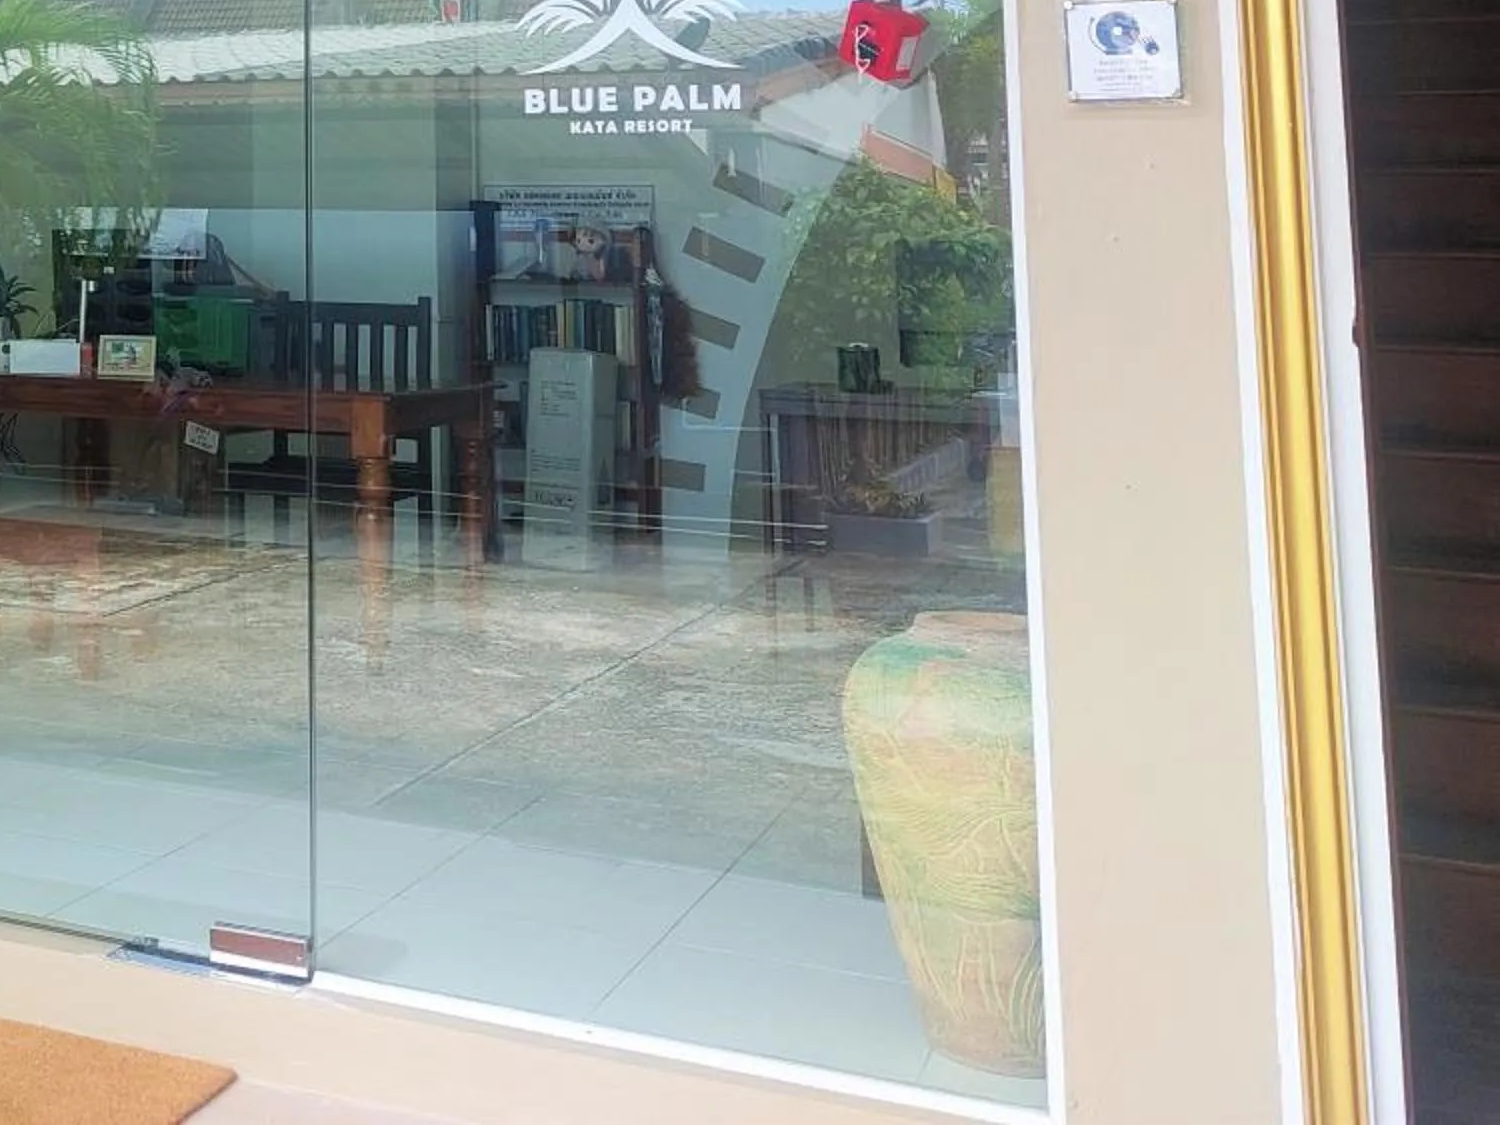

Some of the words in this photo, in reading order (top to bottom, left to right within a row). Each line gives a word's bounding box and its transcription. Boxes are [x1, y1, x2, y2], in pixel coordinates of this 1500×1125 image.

[523, 86, 618, 114] BLUE
[633, 83, 742, 112] PALM
[570, 121, 617, 134] KATA
[624, 119, 693, 134] RESORT
